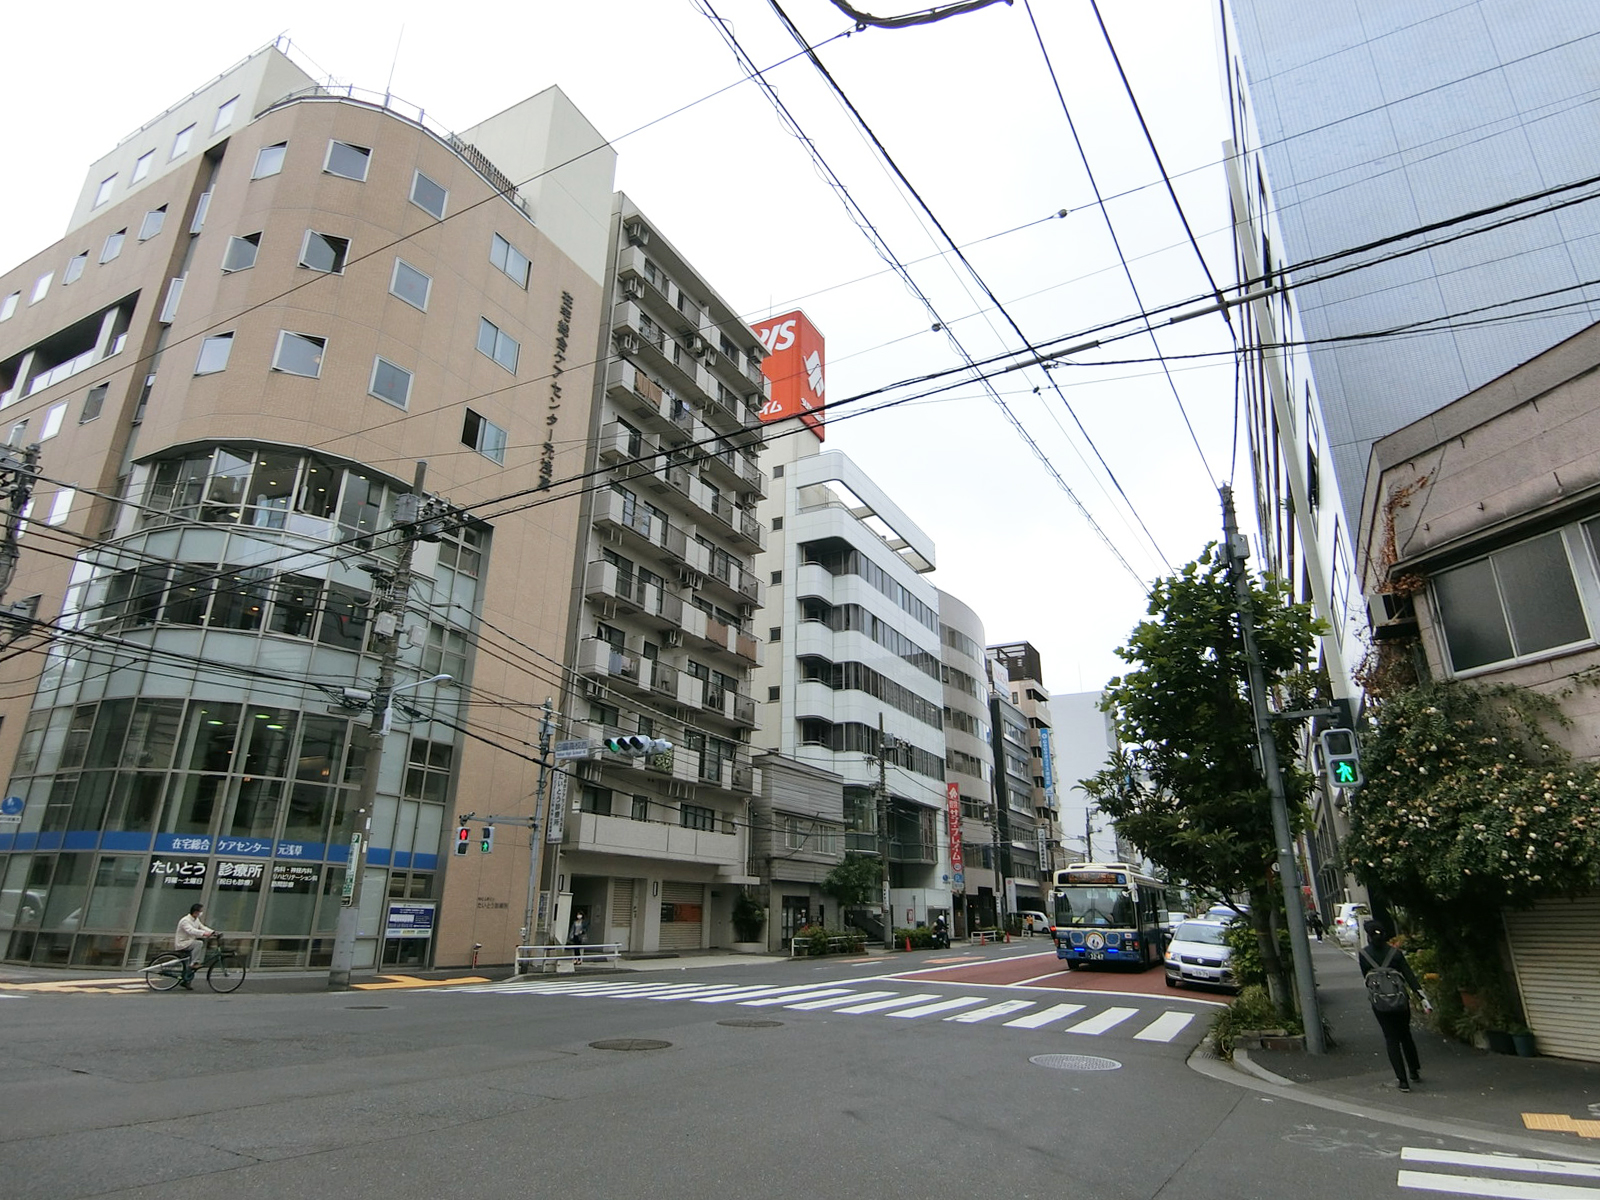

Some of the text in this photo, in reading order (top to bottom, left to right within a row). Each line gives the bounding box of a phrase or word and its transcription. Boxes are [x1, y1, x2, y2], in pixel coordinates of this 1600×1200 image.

[537, 290, 574, 493] 在宅総合ケアセンター元浅草
[172, 838, 303, 856] 在宅総合 ケアセンター 元浅草
[150, 860, 264, 878] たいとう 診療所
